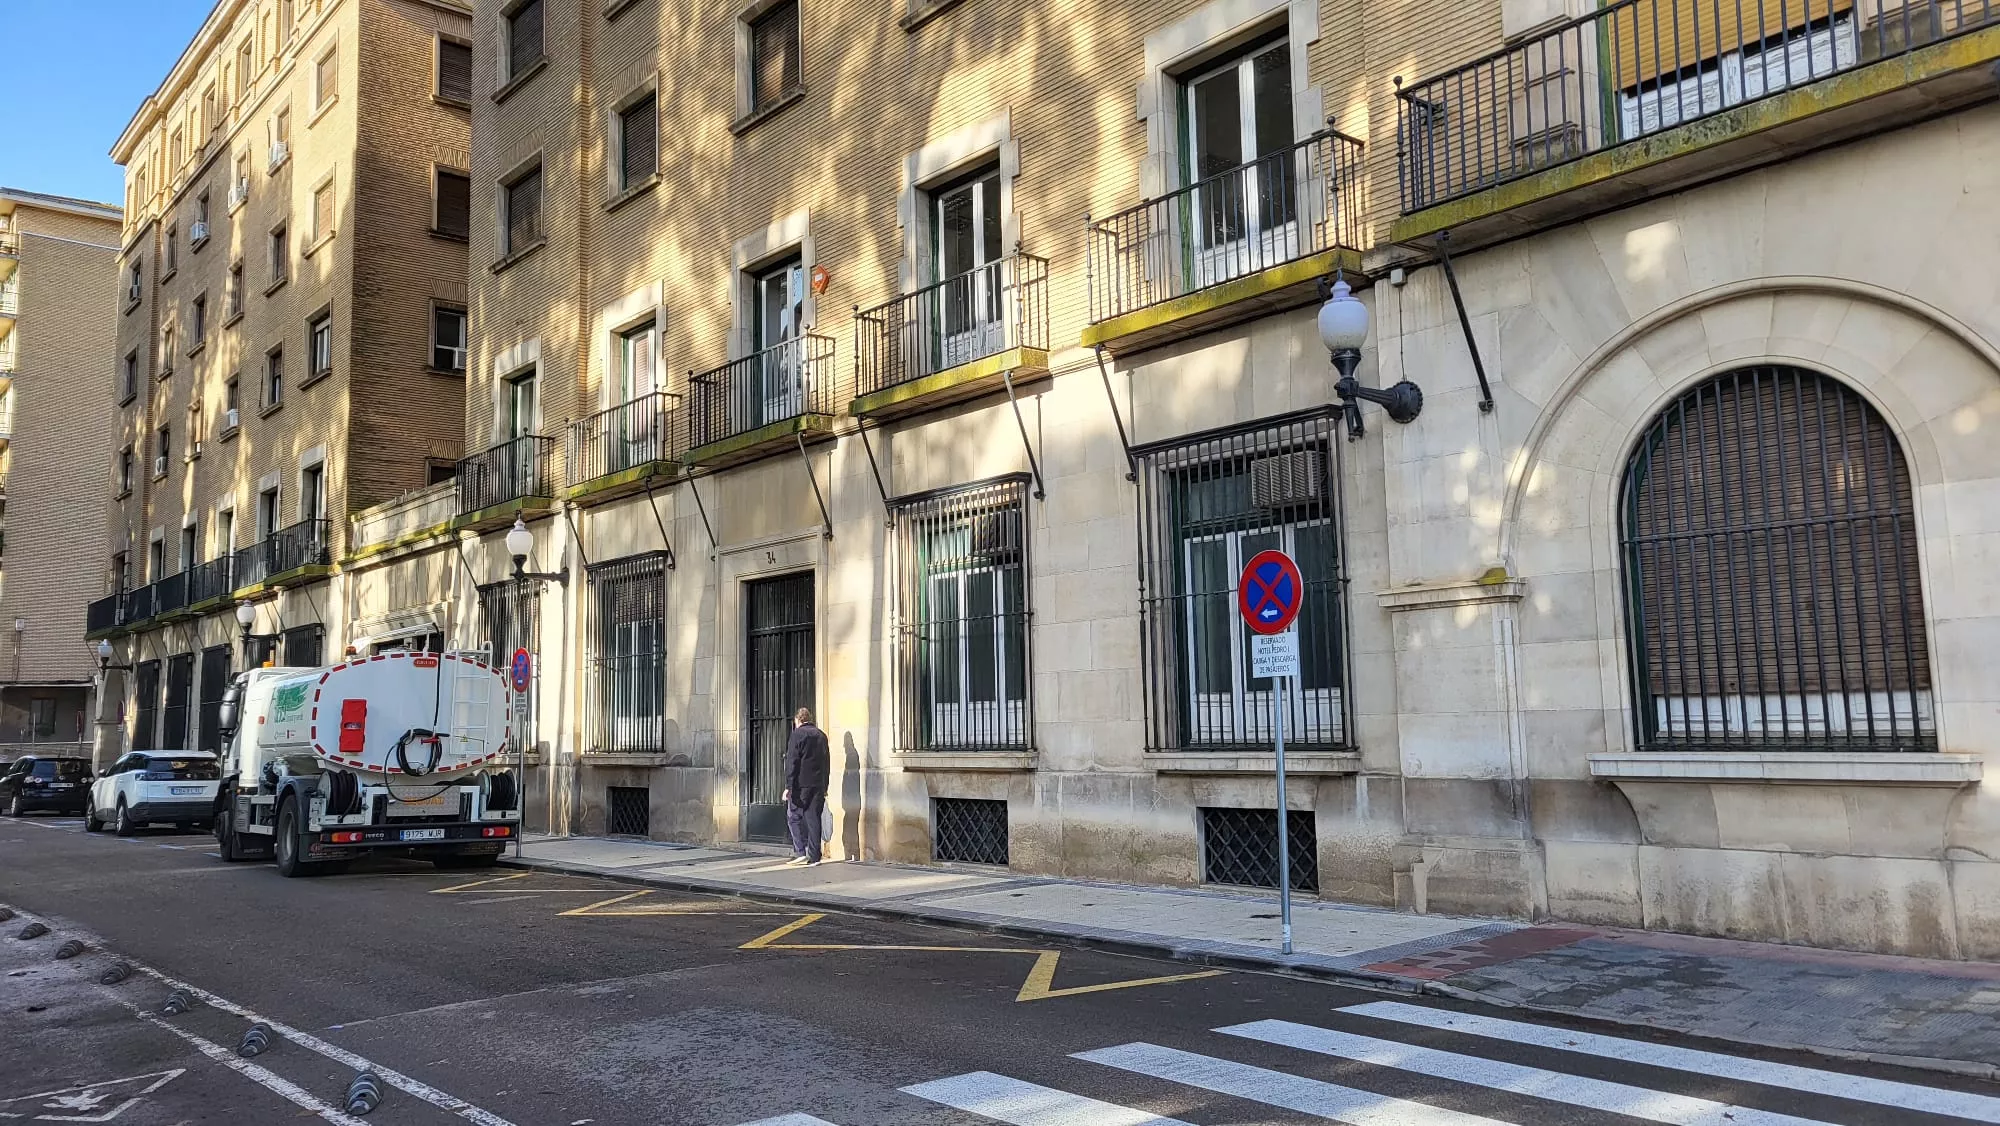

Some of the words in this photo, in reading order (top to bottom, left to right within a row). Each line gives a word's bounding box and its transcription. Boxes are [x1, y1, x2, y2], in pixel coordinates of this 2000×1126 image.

[766, 551, 776, 564] 34
[1260, 636, 1286, 645] RESERVADO
[1257, 647, 1271, 655] HOTEL
[1272, 645, 1287, 653] PEDRO
[1253, 656, 1267, 665] CARGA
[1272, 655, 1296, 663] DESCARGA
[1265, 664, 1290, 673] PASAJEROS
